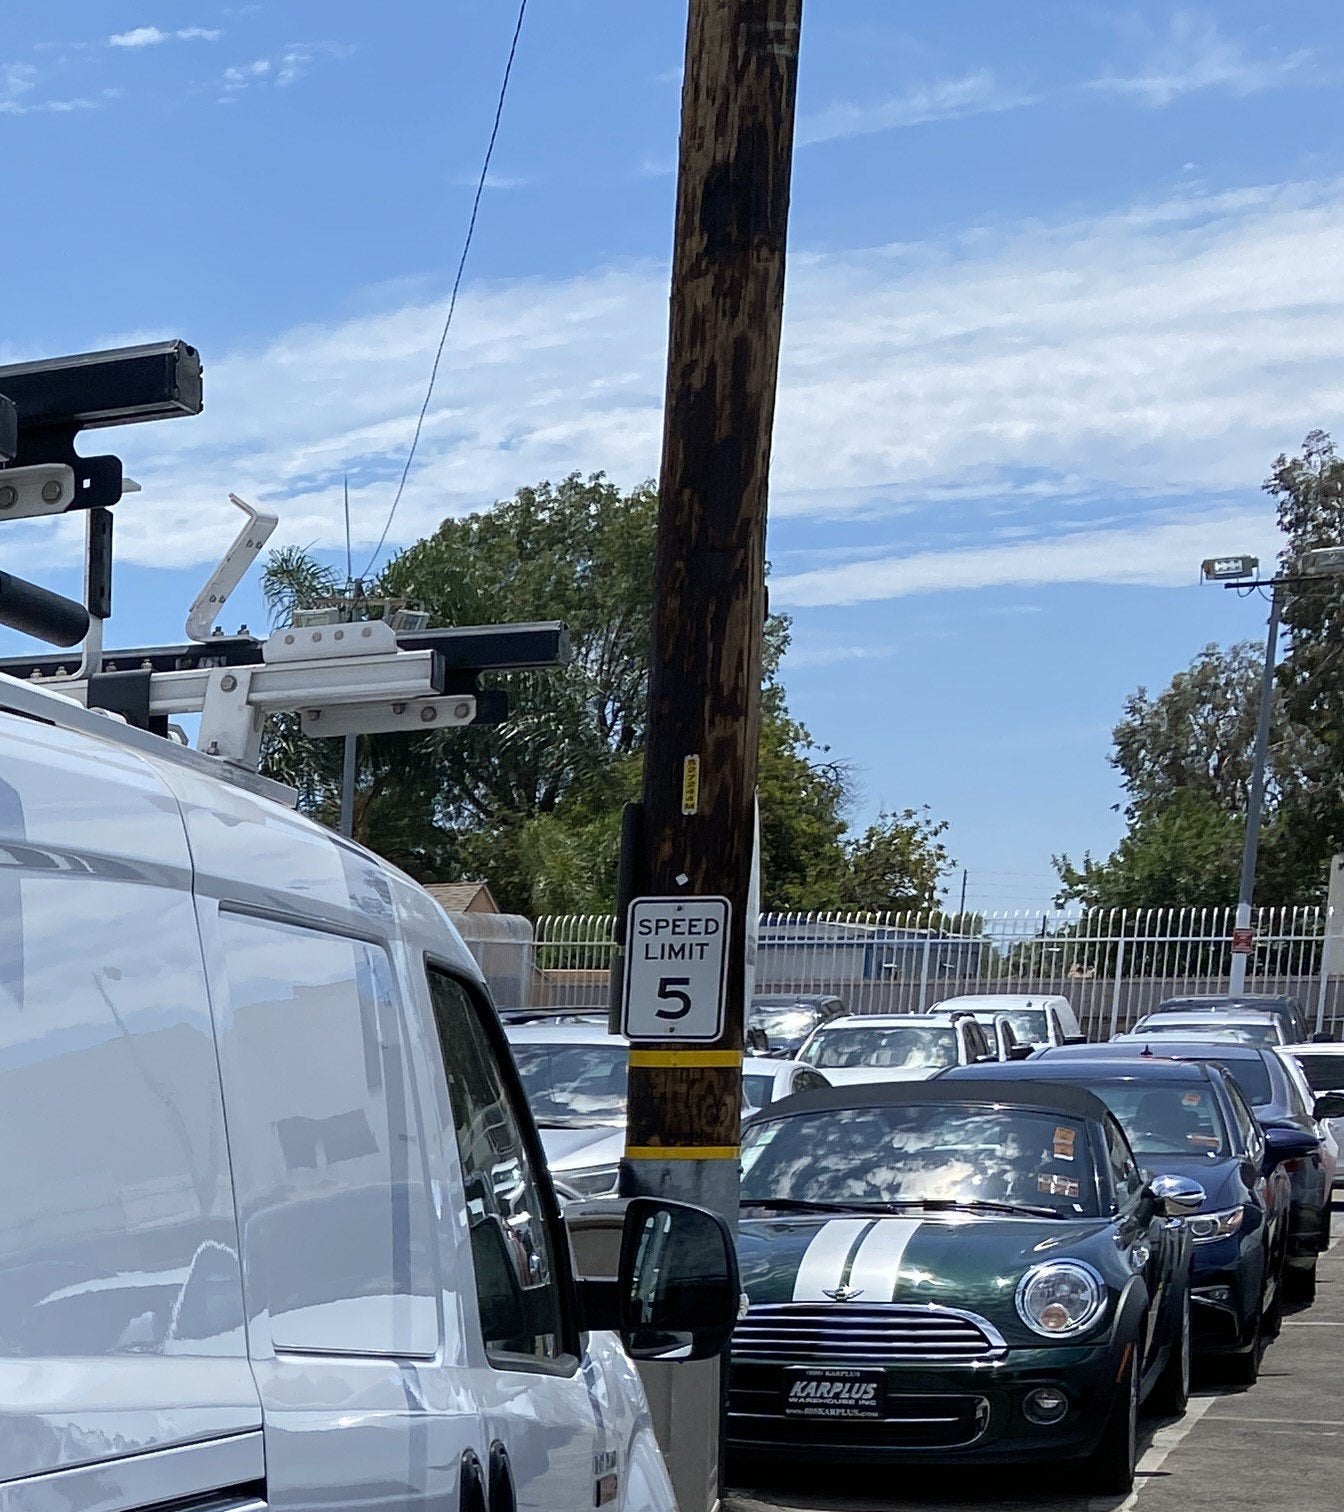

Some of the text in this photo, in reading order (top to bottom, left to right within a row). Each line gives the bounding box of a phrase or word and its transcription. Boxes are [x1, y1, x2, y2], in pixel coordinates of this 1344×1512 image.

[638, 918, 720, 936] SPEED
[644, 943, 709, 960] LIMIT
[655, 977, 692, 1020] 5
[789, 1381, 878, 1399] KARPLUS
[788, 1397, 856, 1405] WAREHOUSE
